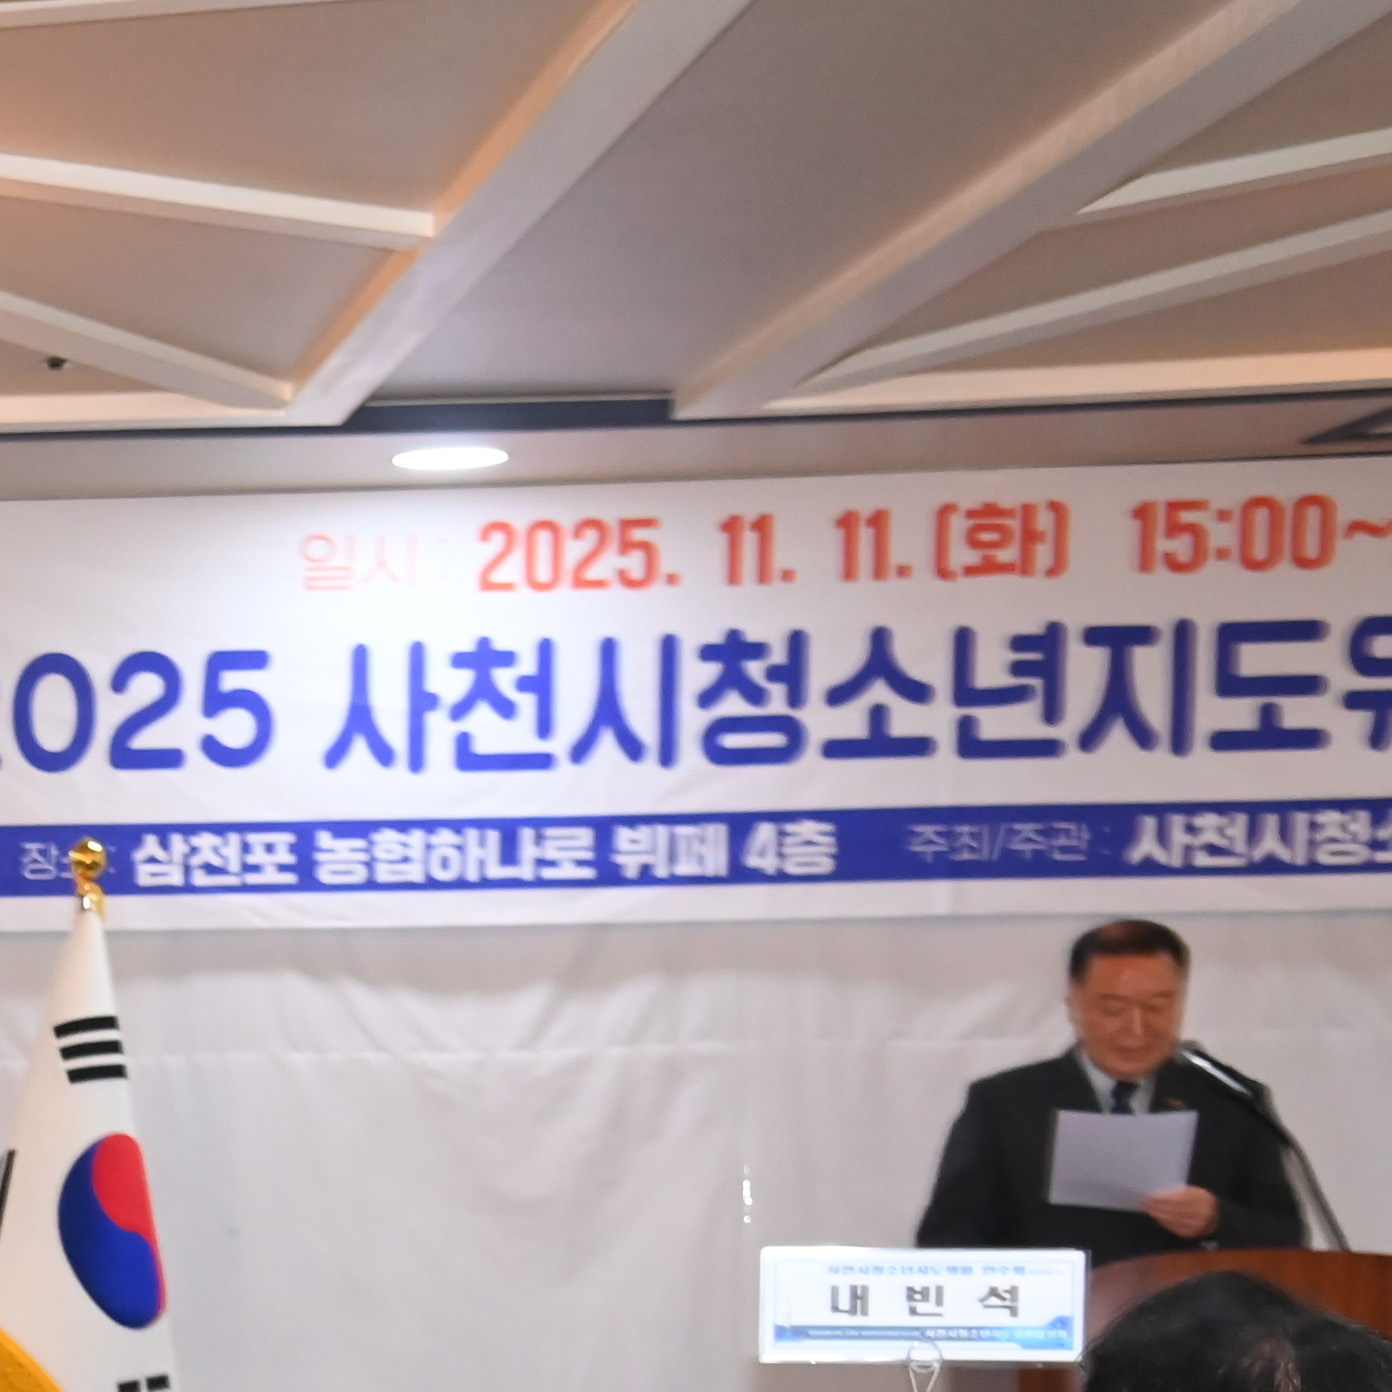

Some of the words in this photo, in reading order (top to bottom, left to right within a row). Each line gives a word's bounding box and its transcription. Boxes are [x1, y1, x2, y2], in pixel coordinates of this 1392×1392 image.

[299, 531, 417, 592] 일시
[478, 517, 681, 593] 2025.
[130, 830, 301, 888] 삼천포
[312, 826, 598, 886] 농협하나로
[609, 822, 730, 879] 뷔페
[741, 820, 838, 878] 4층
[906, 821, 1092, 863] 주최/주관
